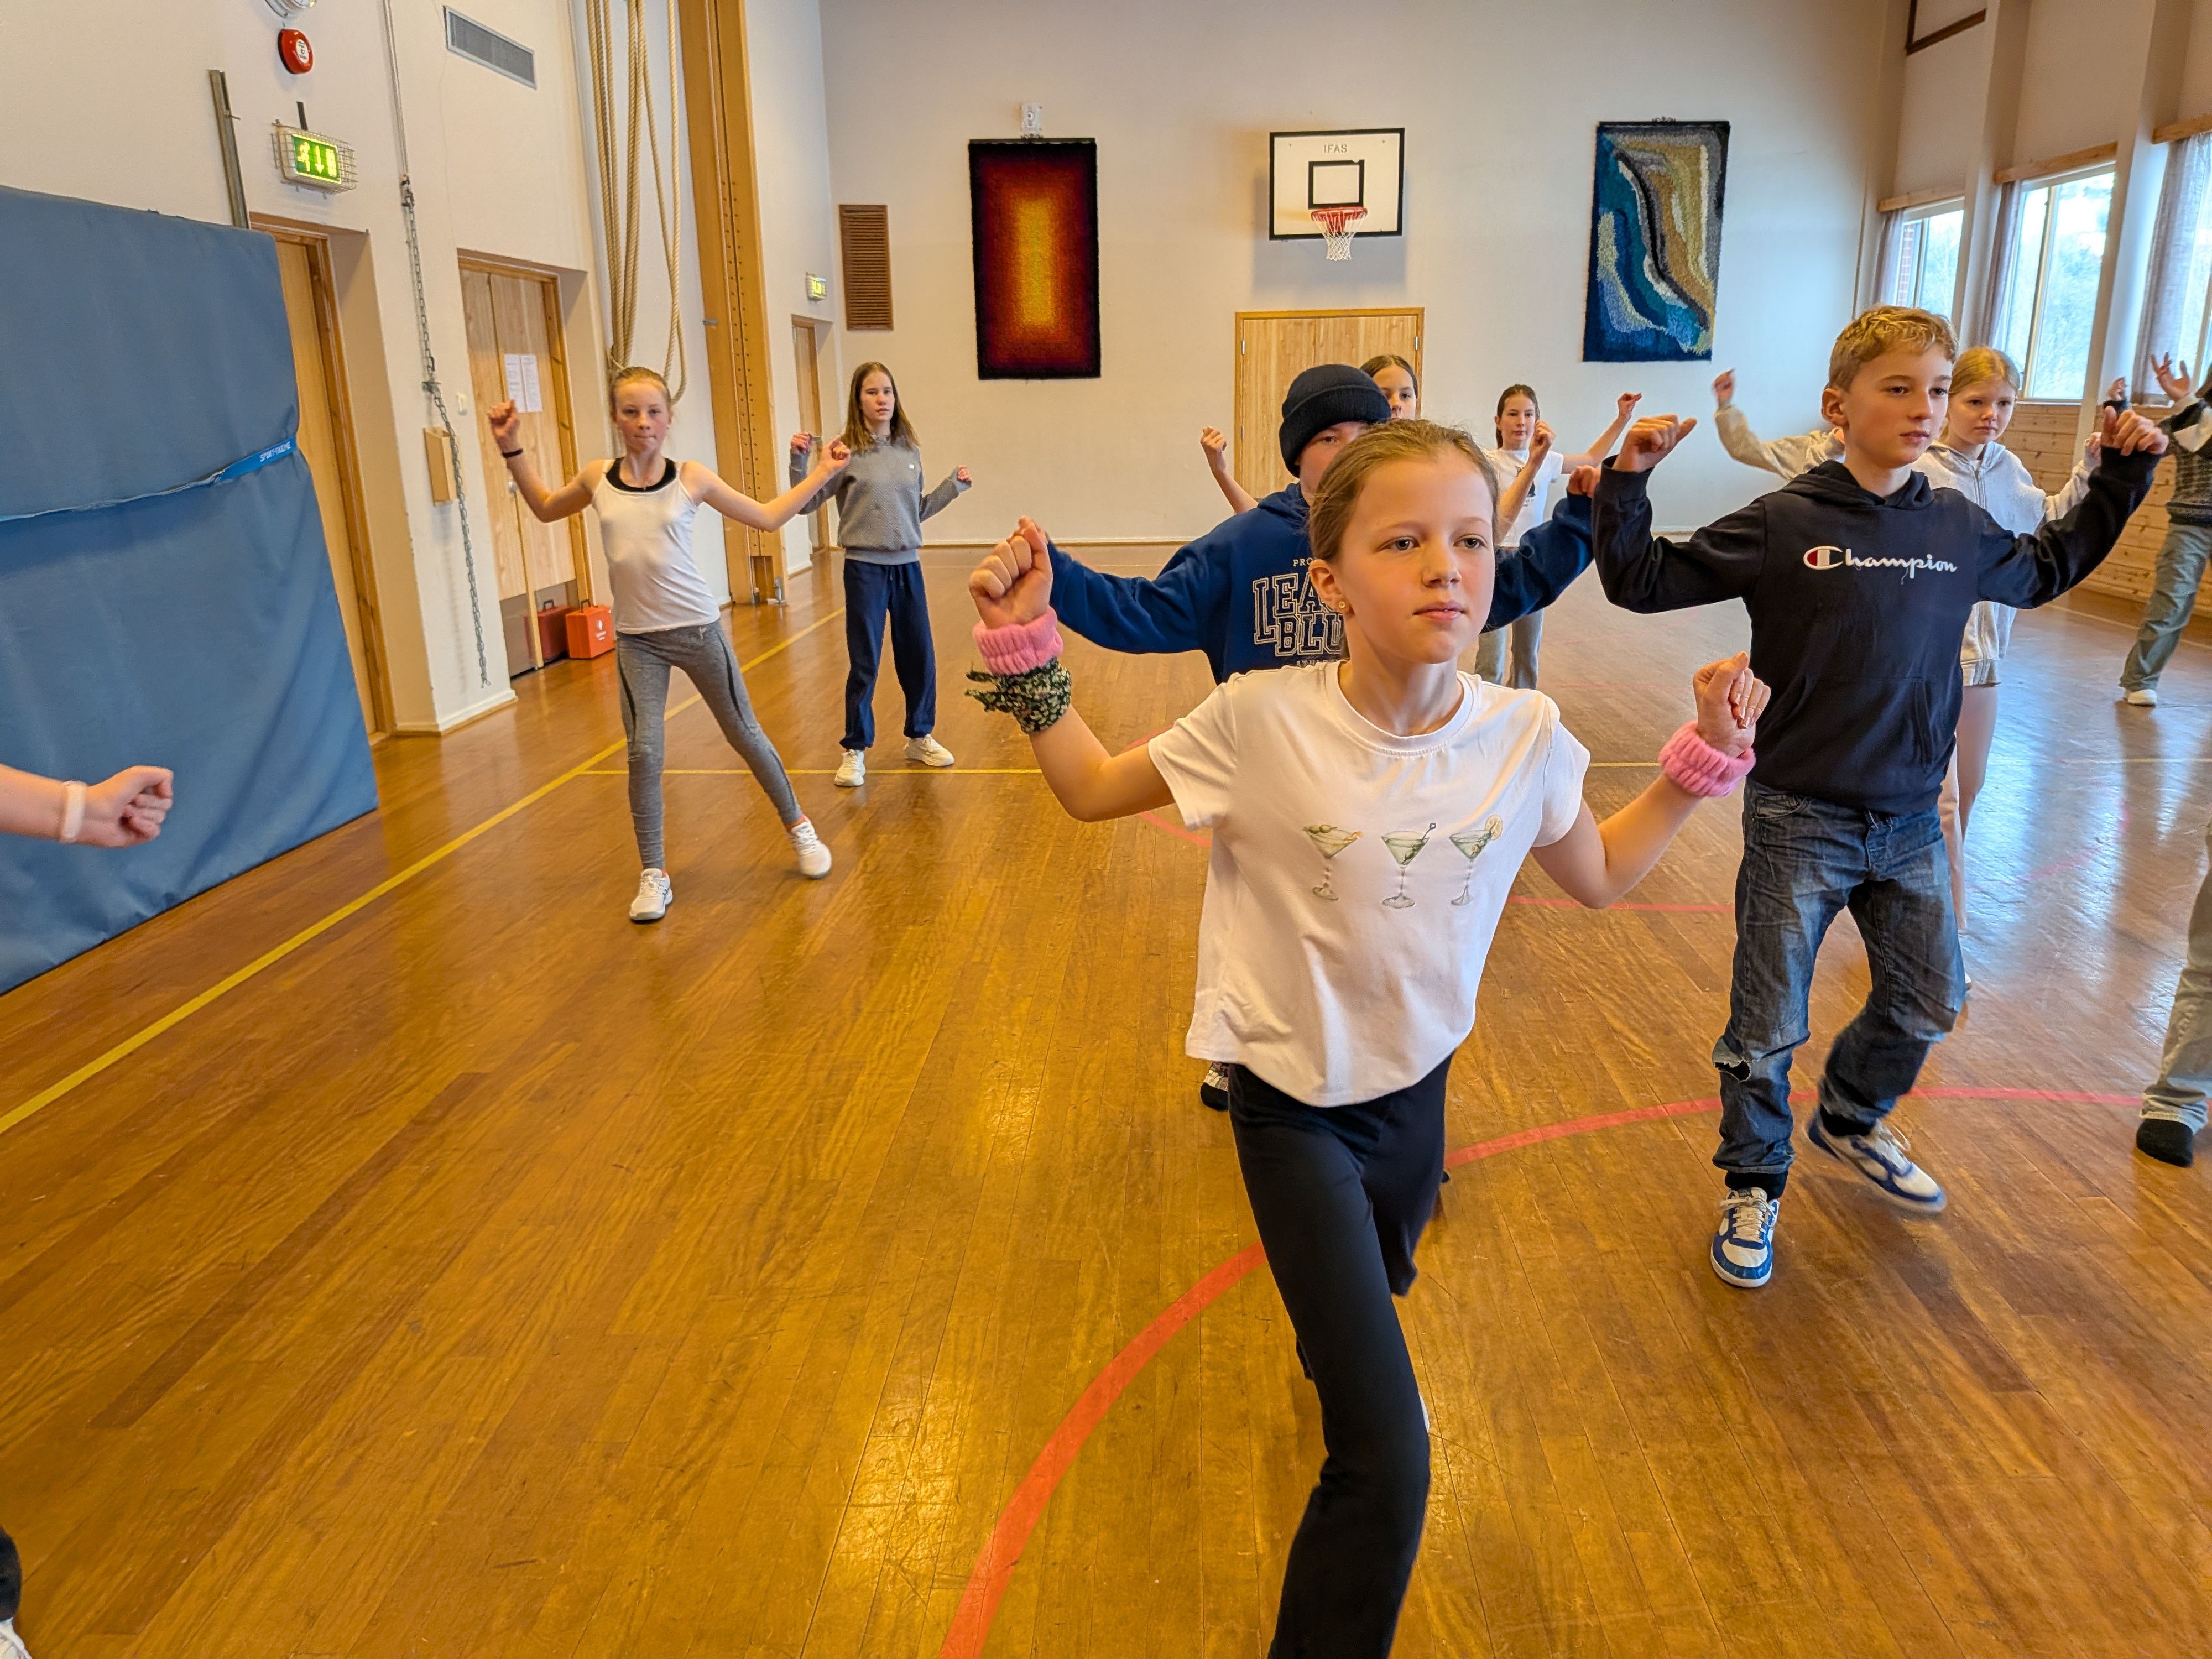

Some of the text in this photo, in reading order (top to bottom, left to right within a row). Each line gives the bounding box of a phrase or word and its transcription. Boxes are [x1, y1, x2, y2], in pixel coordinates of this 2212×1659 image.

[1324, 144, 1348, 153] IFAS
[1293, 557, 1316, 567] PRO
[1803, 545, 1958, 579] Champion
[1252, 572, 1334, 645] LEA
